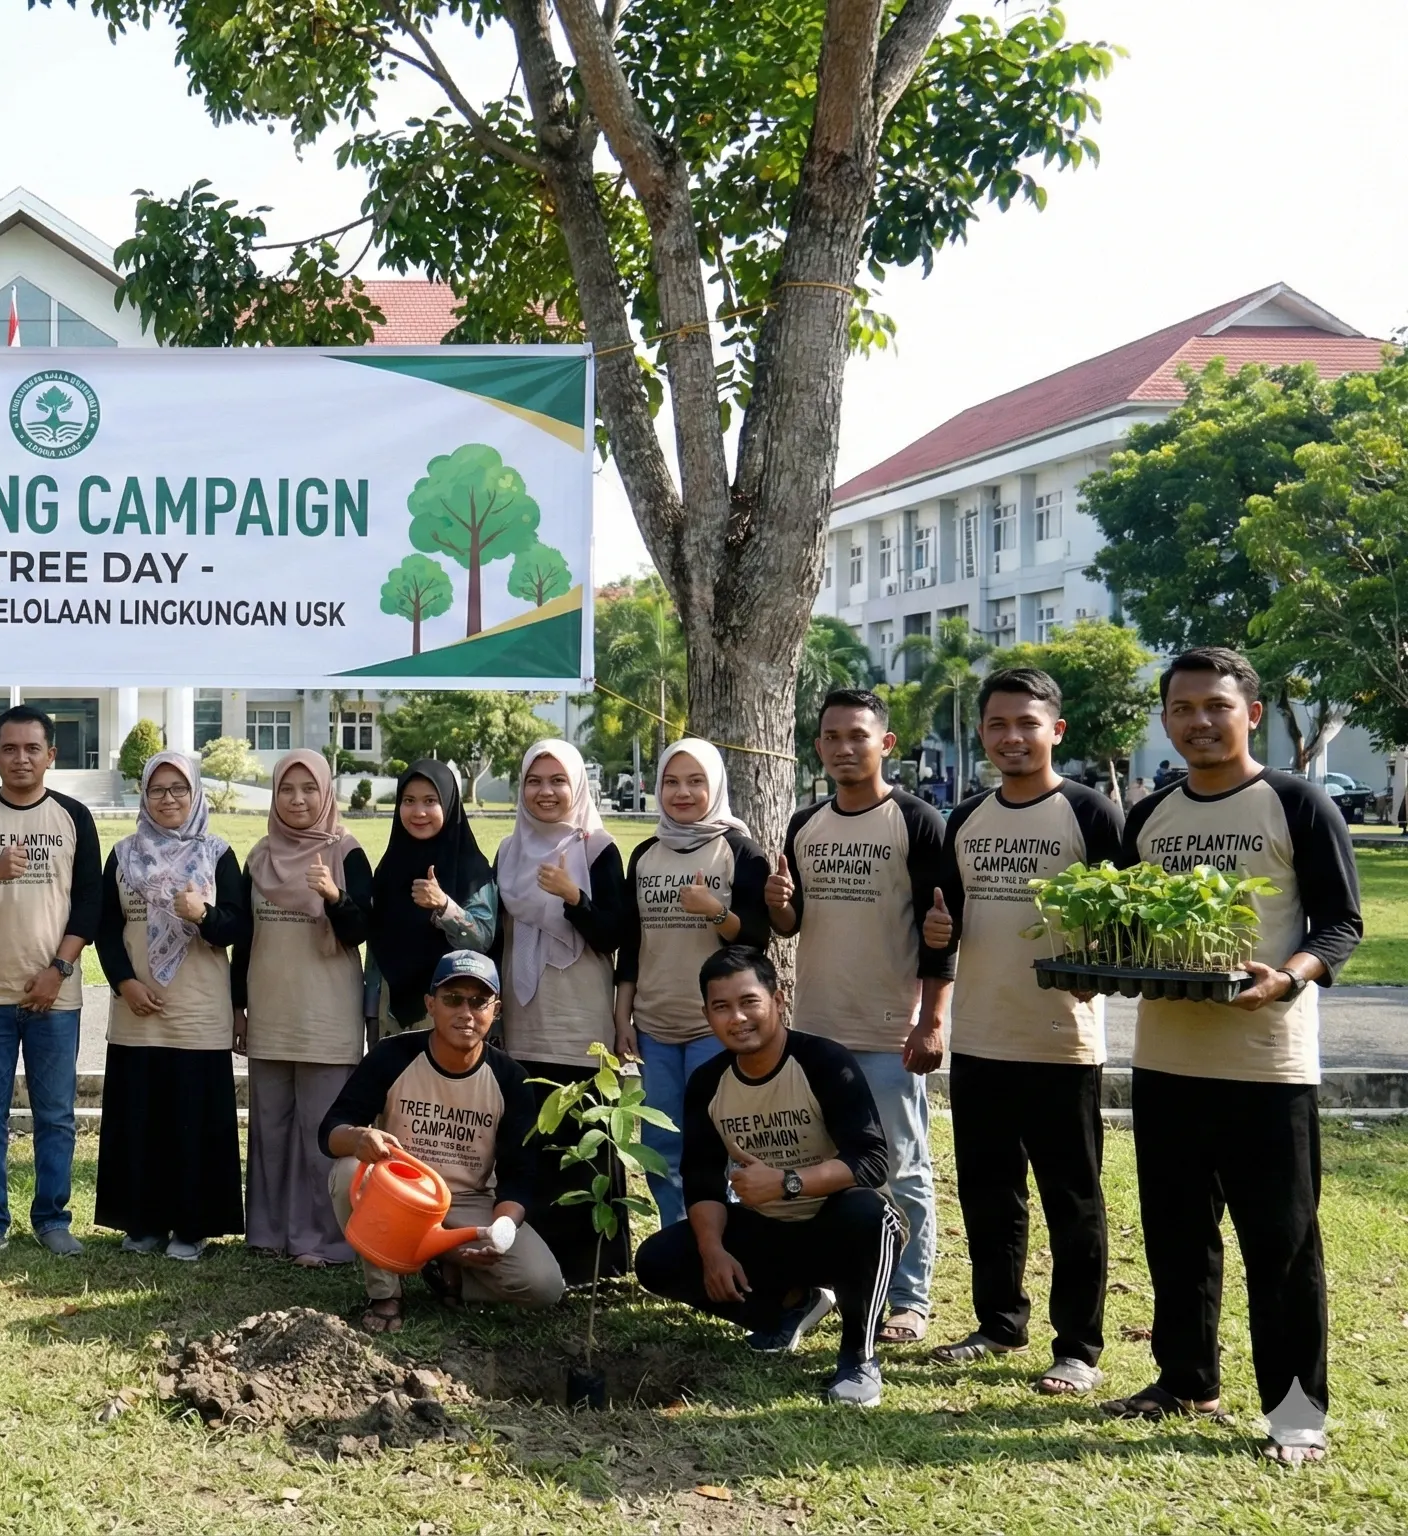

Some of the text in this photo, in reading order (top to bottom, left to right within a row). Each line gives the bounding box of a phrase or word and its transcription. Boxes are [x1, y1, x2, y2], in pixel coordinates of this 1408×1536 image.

[79, 475, 368, 537] CAMPAIGN
[103, 552, 188, 583] DAY
[121, 600, 286, 626] LINGKUNGAN
[296, 602, 345, 626] USK
[831, 843, 892, 860] PLANTING
[964, 838, 1060, 856] TREE PLANTING
[1151, 834, 1263, 854] TREE PLANTING
[974, 856, 1038, 873] CAMPAIGN
[1162, 854, 1236, 873] CAMPAIGN
[664, 874, 721, 890] PLANNG
[400, 1099, 492, 1128] TREE PLANTING
[720, 1108, 810, 1136] TREE PLANTING
